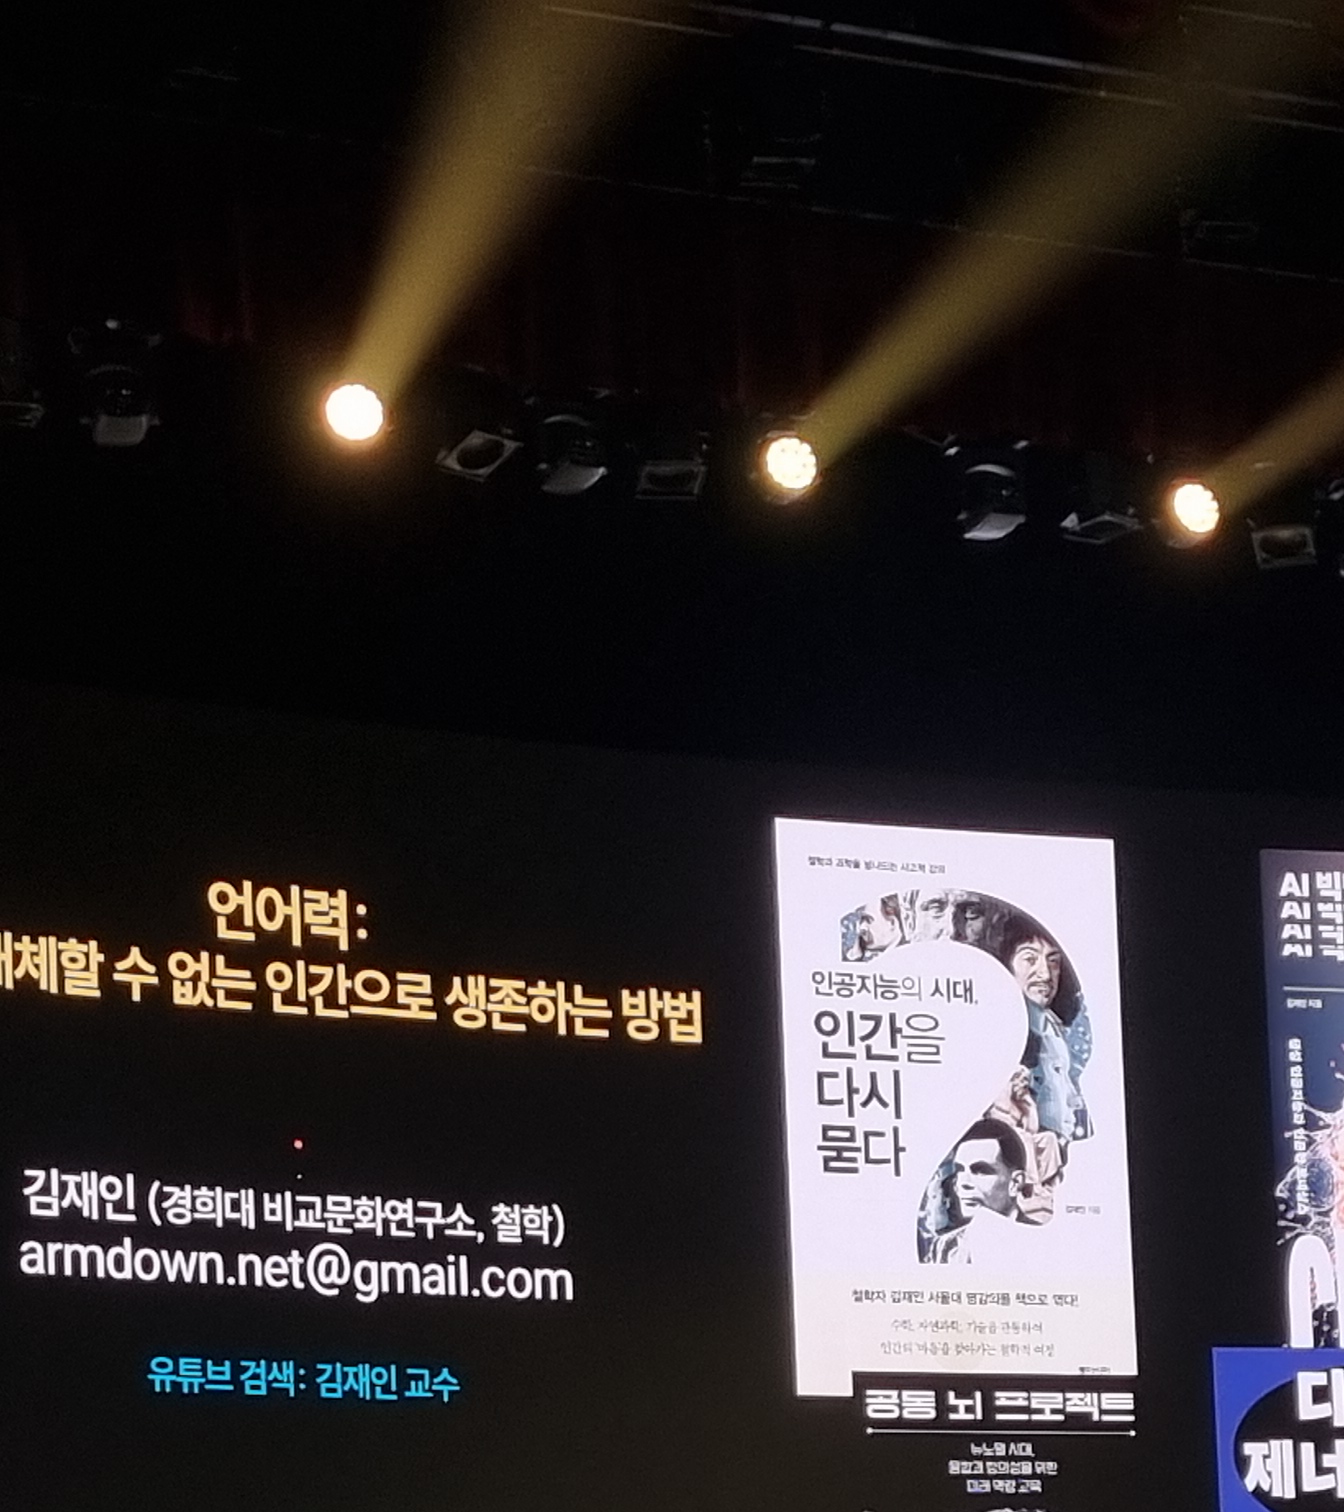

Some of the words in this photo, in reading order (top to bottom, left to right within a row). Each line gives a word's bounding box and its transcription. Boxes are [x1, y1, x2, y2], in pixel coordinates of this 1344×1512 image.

[1279, 872, 1310, 897] AI
[207, 880, 368, 951] 언어력:
[113, 946, 159, 1001] 수
[168, 951, 256, 1010] 없는
[266, 960, 437, 1020] 인간으로
[444, 975, 612, 1037] 생존하는
[621, 988, 702, 1044] 방법
[811, 971, 922, 1001] 인공지능의
[930, 977, 978, 1005] 시대,
[814, 1010, 945, 1064] 인간을
[816, 1066, 902, 1120] 다시
[816, 1124, 906, 1177] 묻다
[23, 1168, 137, 1221] 김재인
[148, 1180, 255, 1229] (경희대
[263, 1191, 484, 1243] 비교문화연구소,
[492, 1203, 564, 1247] 철학)
[20, 1234, 573, 1303] armdown.net@gmail.com
[148, 1357, 234, 1393] 유튜브
[240, 1360, 306, 1397] 검색:
[316, 1362, 397, 1400] 김재인
[405, 1368, 460, 1402] 교수
[865, 1389, 937, 1420] 공동
[947, 1390, 983, 1420] 뇌
[994, 1391, 1136, 1422] 프로젝트
